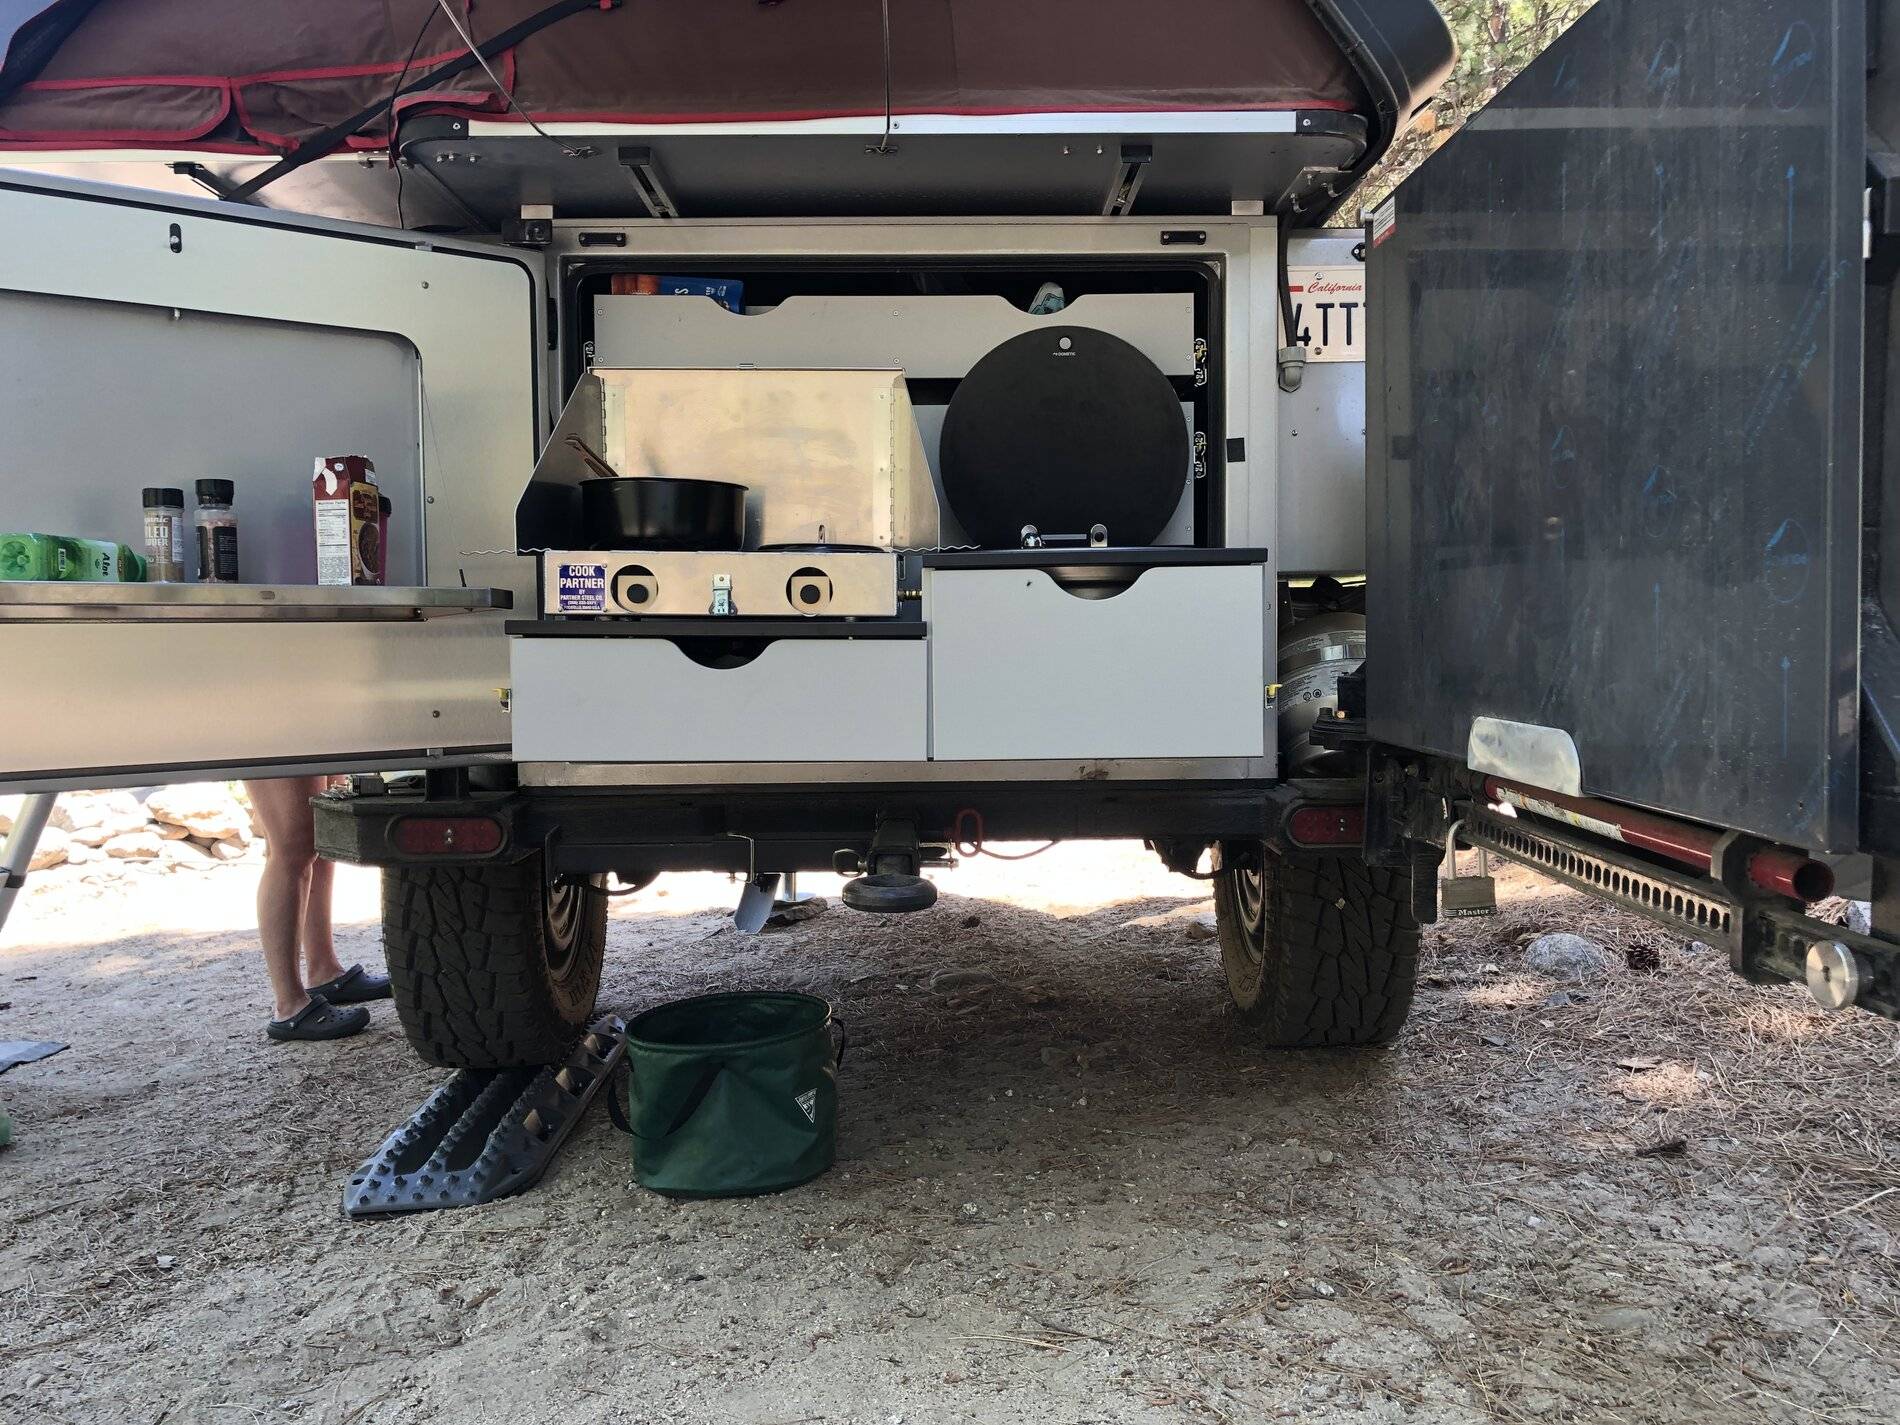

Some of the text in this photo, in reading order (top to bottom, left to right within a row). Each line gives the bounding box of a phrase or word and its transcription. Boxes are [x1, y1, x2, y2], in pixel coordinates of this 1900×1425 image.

[1307, 281, 1362, 294] California
[1294, 303, 1366, 346] 4TT
[102, 552, 111, 576] Aloe
[568, 565, 596, 577] COOK
[560, 578, 605, 589] PARTNER
[1458, 908, 1489, 916] Master
